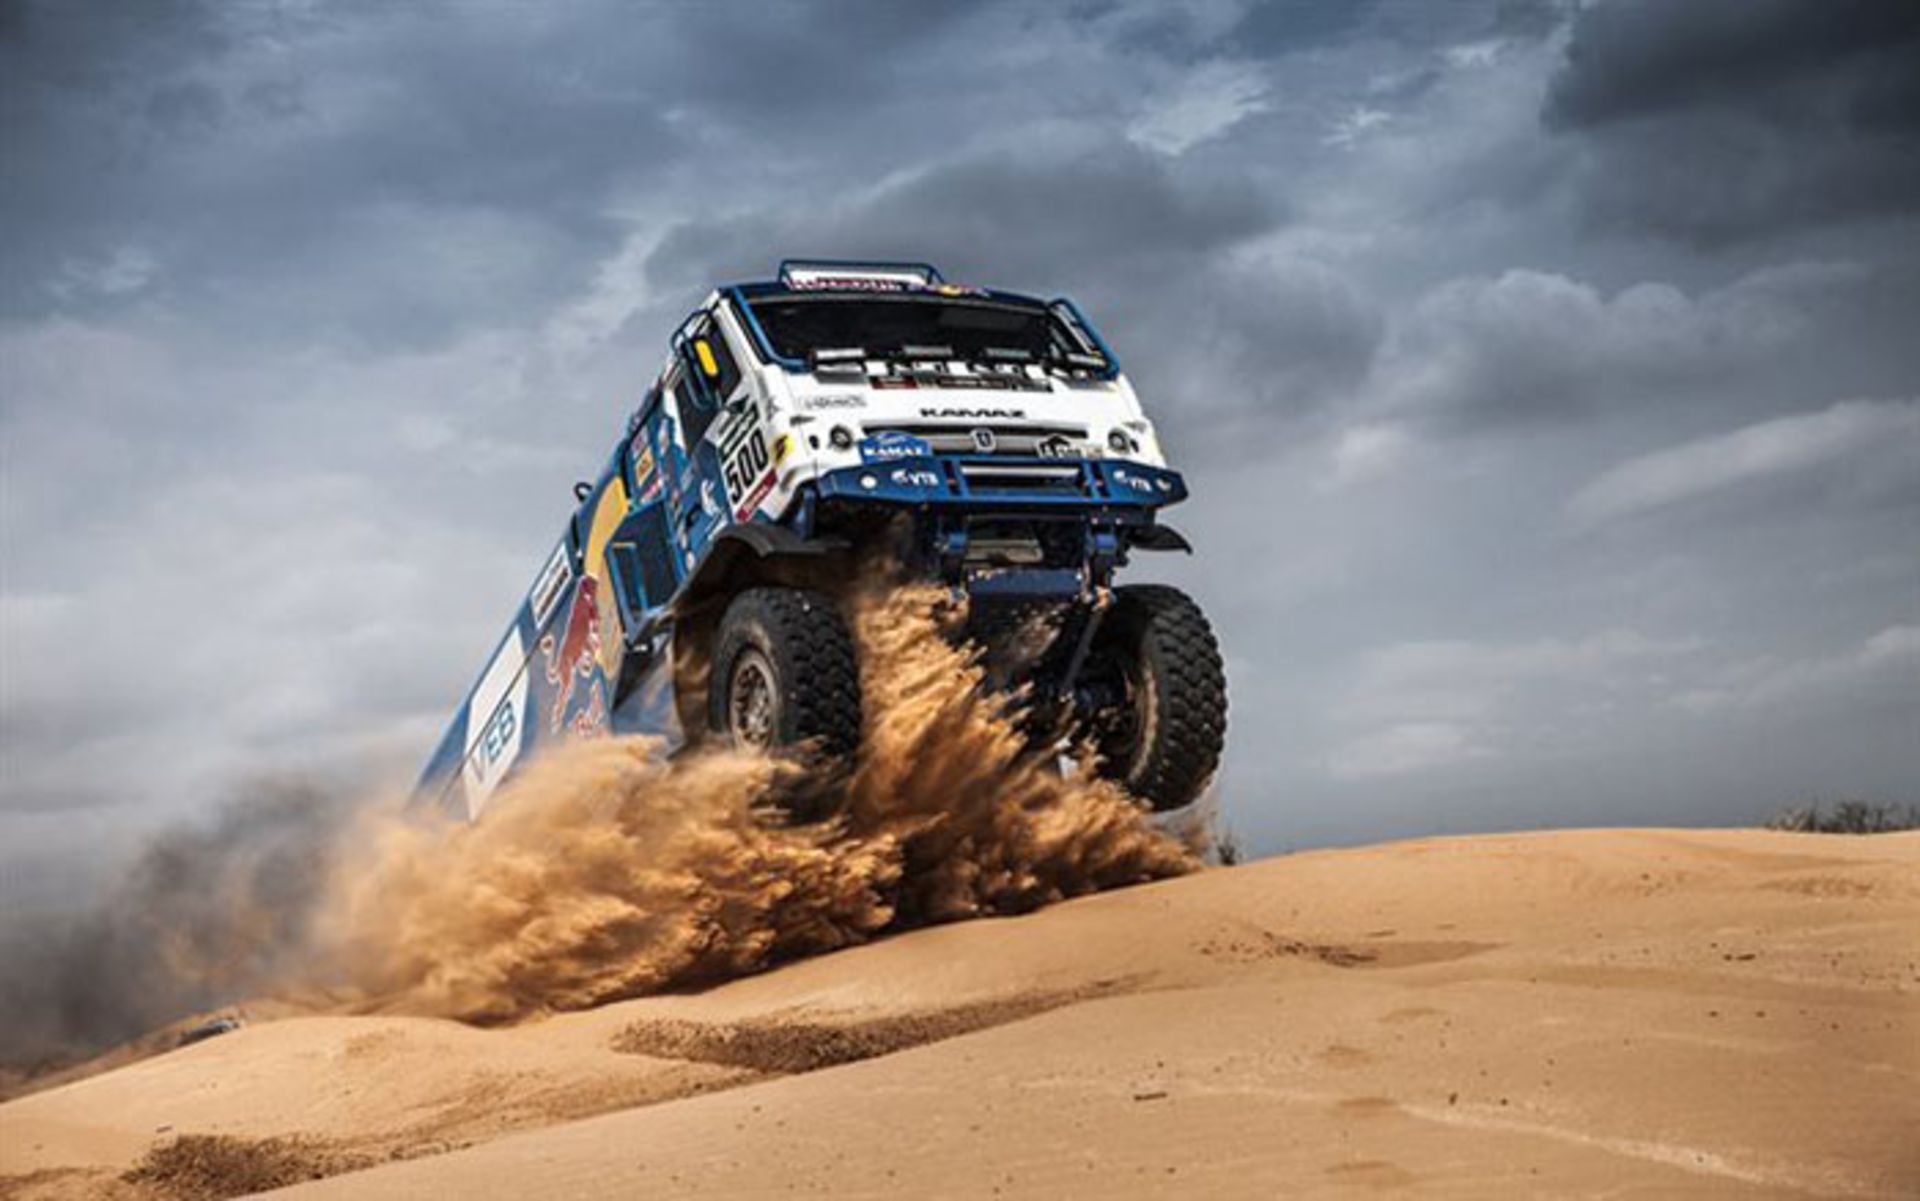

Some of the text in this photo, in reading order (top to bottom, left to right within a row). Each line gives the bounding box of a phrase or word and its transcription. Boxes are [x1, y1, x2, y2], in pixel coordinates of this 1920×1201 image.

[919, 407, 1027, 418] KAMAZ
[724, 427, 769, 504] 500
[471, 699, 517, 783] VEB
